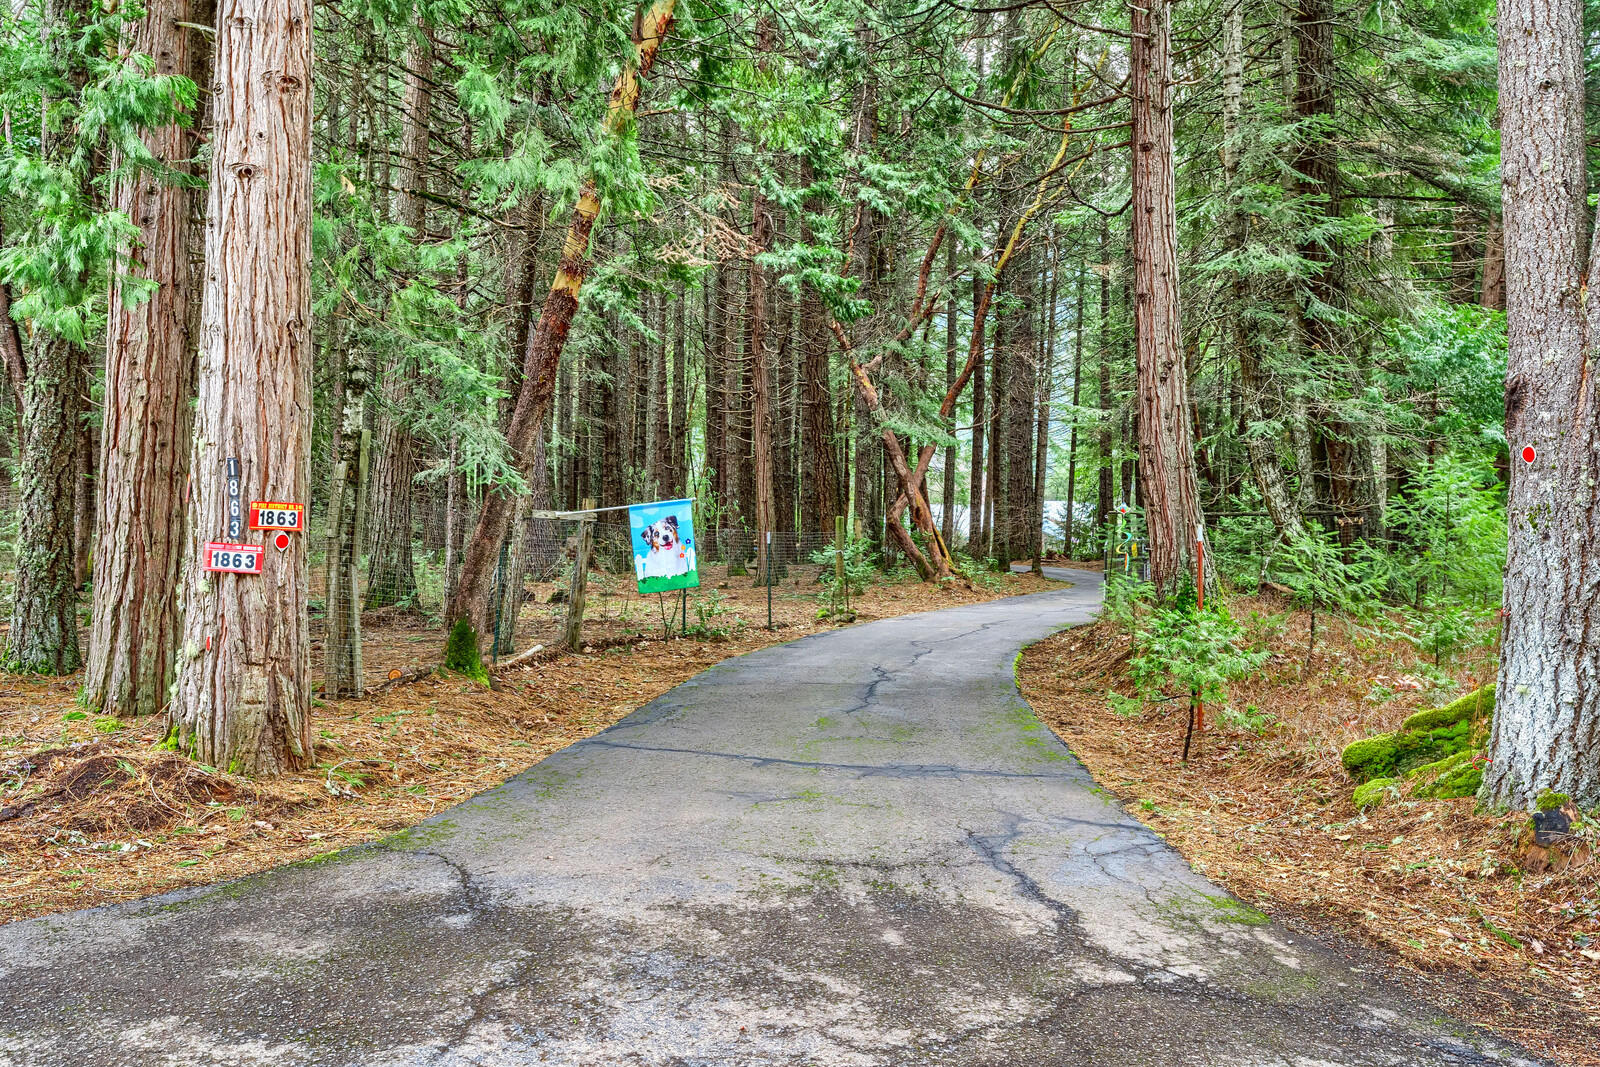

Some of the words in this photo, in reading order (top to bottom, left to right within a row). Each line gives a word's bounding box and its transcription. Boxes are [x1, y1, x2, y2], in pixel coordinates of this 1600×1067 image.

[229, 459, 240, 537] 1863
[259, 510, 297, 526] 1863
[212, 551, 255, 569] 1863
